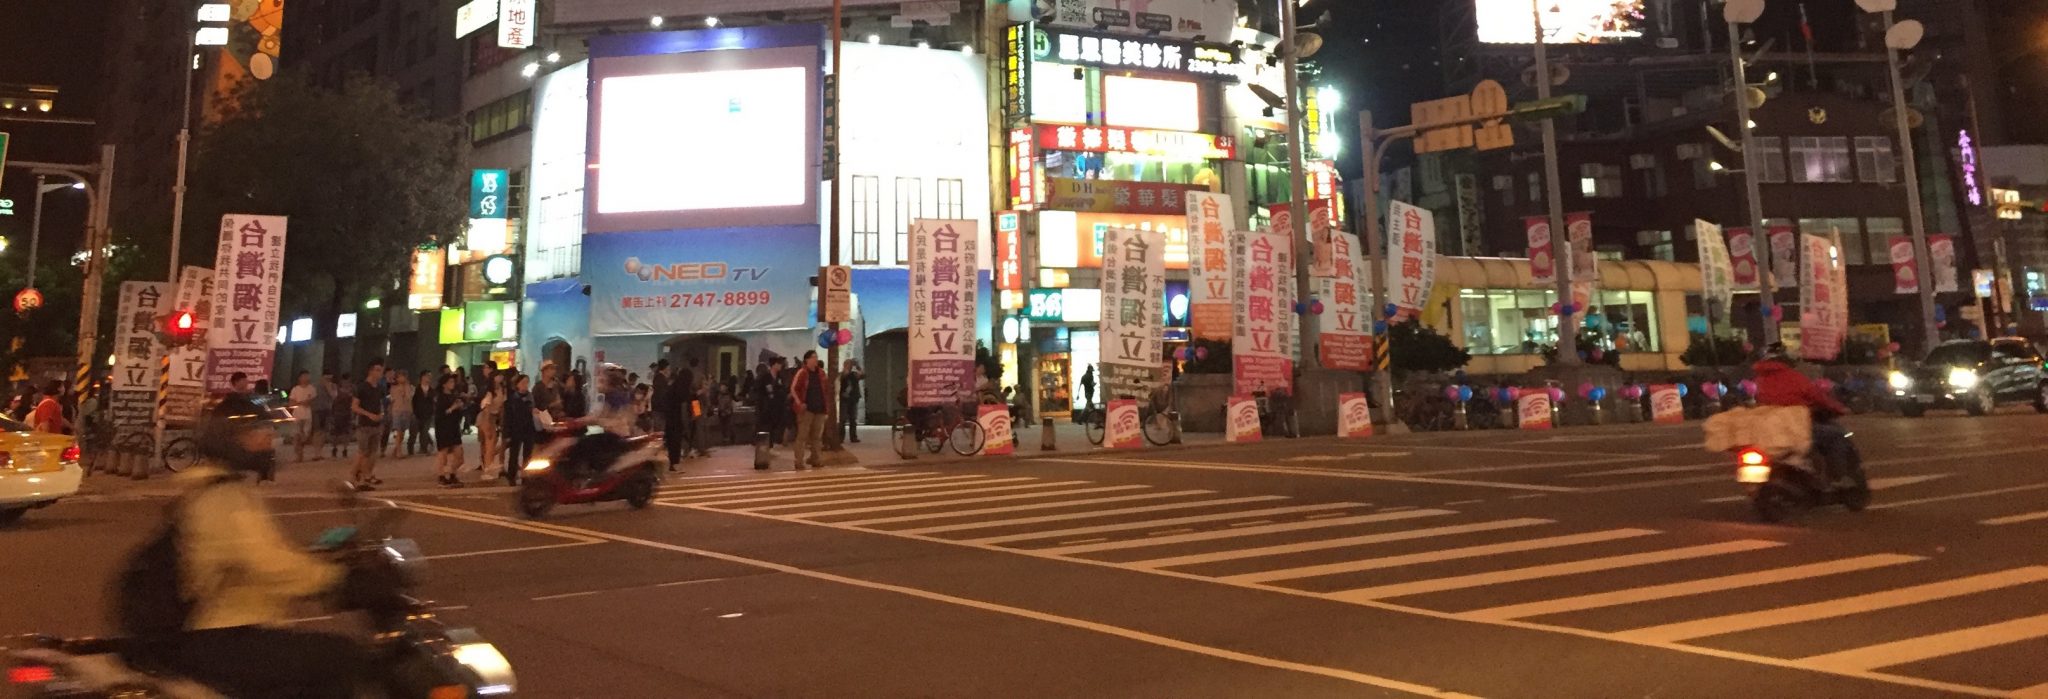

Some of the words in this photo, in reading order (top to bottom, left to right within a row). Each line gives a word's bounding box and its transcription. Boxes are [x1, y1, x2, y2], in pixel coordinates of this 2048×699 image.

[506, 0, 526, 45] 地產
[653, 262, 728, 281] NEO
[732, 267, 769, 281] TV
[670, 290, 770, 309] 2747-8899
